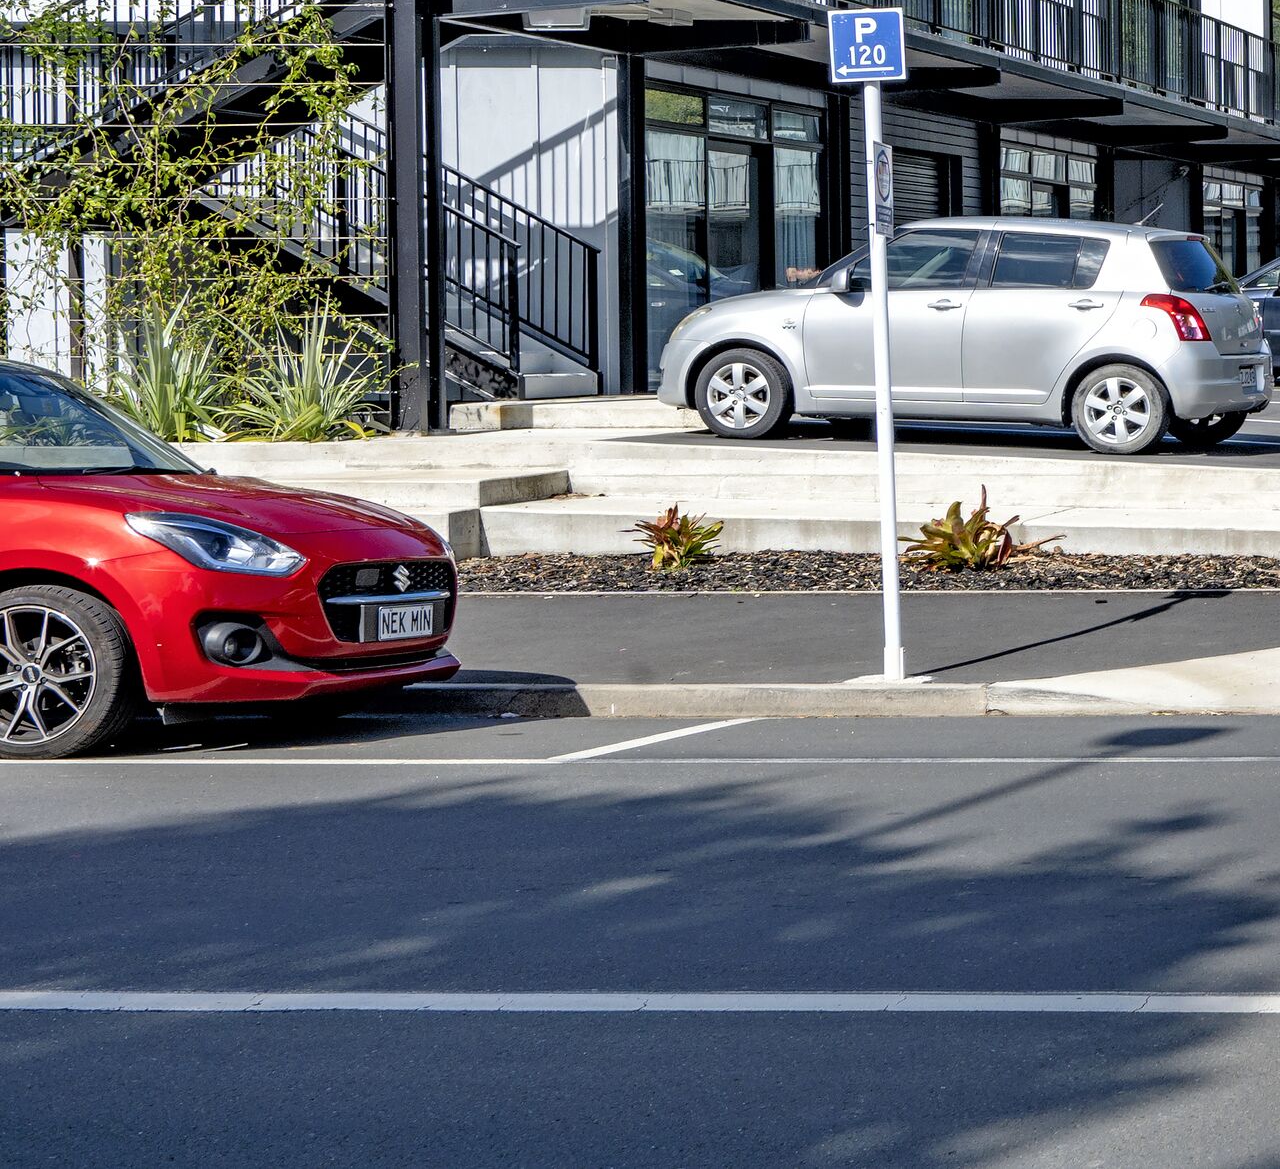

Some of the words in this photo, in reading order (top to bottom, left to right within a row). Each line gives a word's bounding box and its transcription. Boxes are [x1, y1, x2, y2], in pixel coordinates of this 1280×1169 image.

[855, 17, 877, 43] P
[849, 44, 886, 66] 120
[382, 611, 407, 635] NEK
[411, 609, 431, 632] MIN
